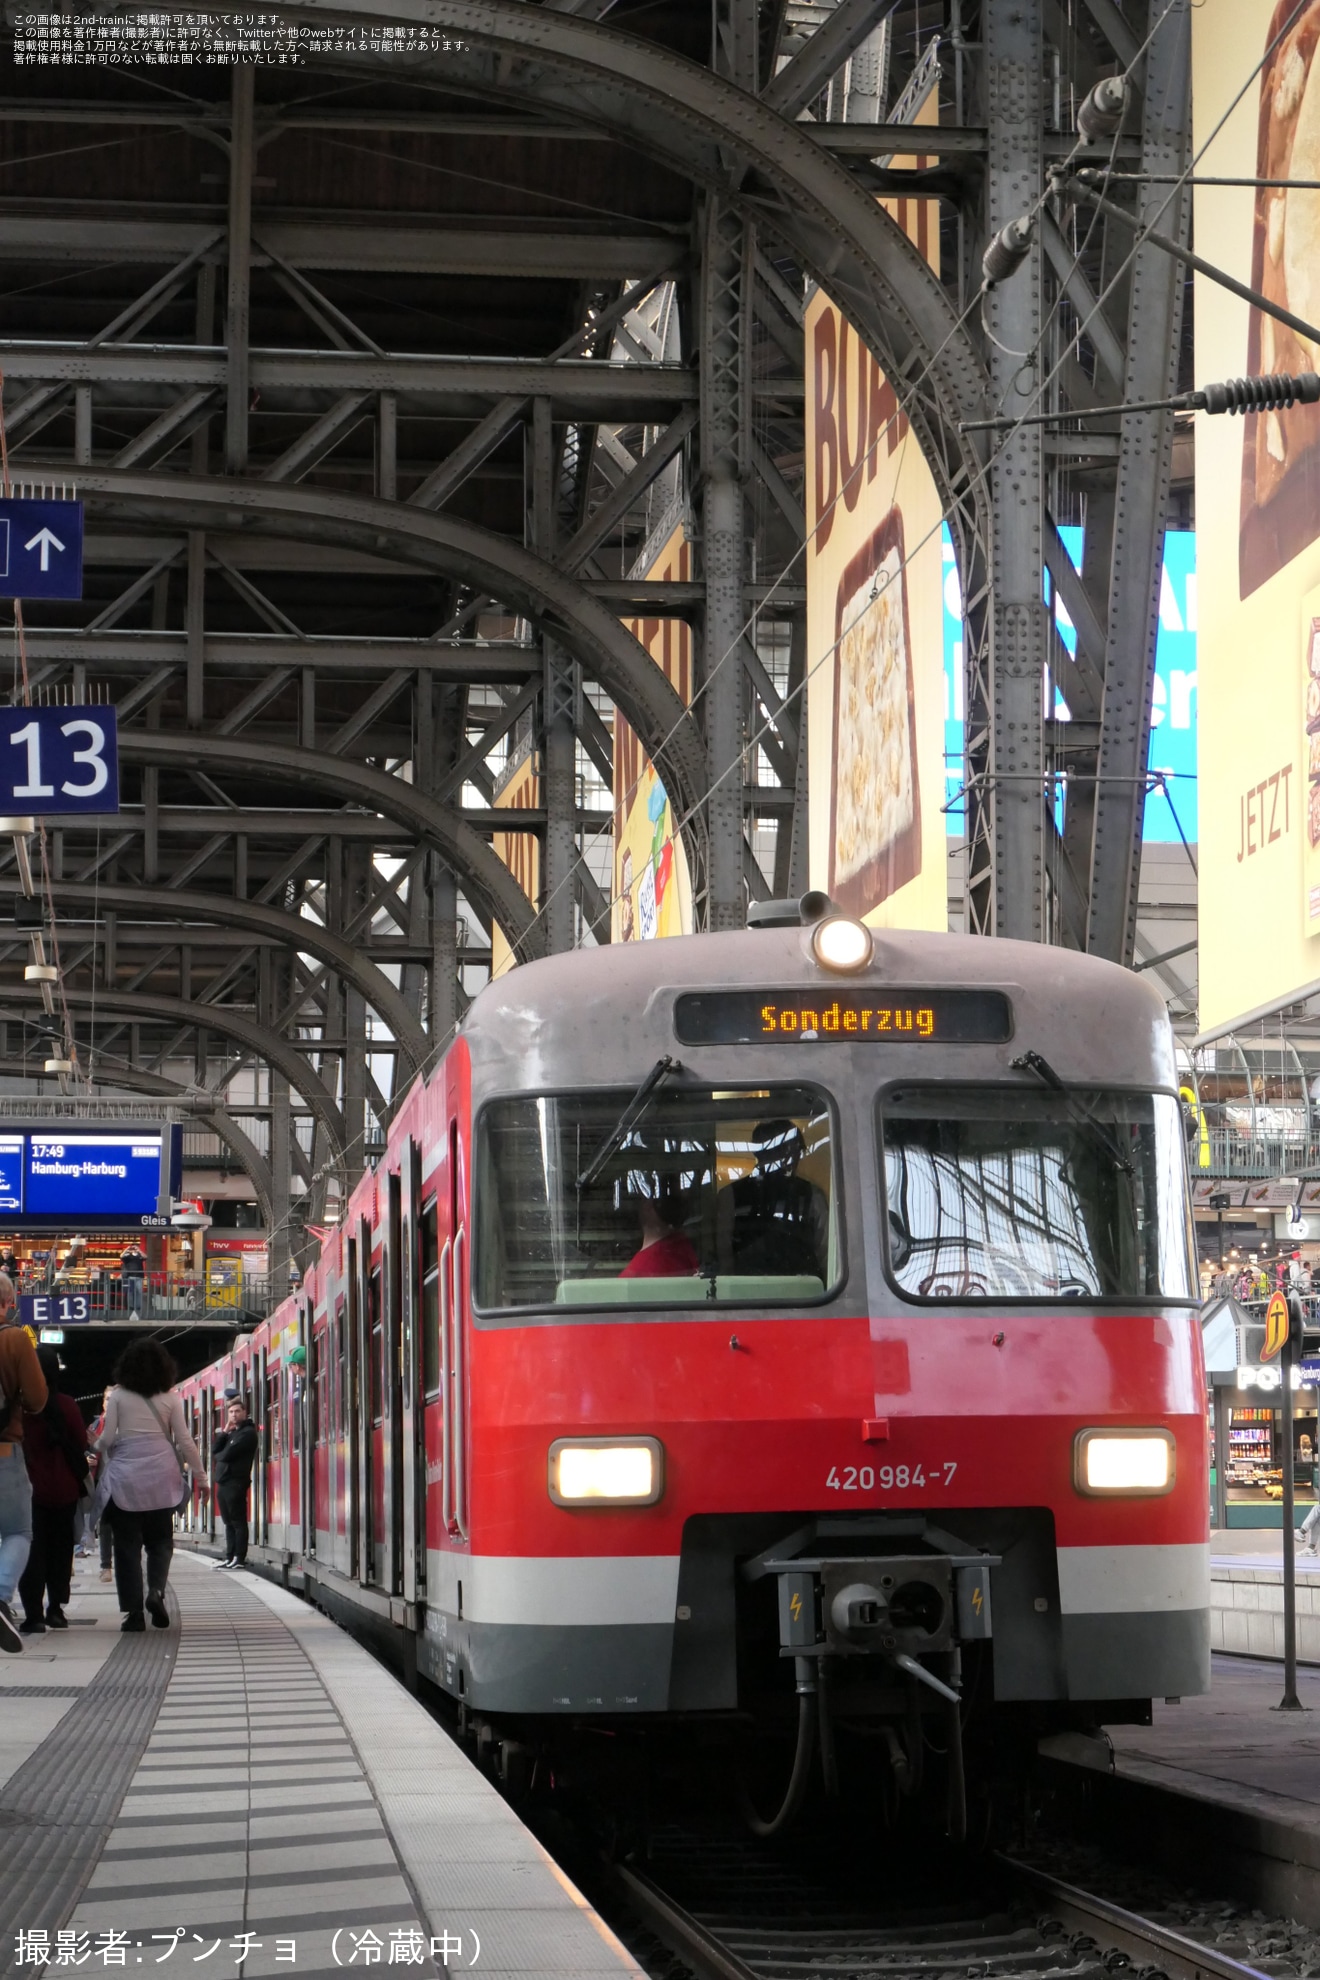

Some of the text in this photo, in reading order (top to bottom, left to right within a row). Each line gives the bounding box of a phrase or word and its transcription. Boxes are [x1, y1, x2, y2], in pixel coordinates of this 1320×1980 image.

[10, 719, 109, 798] 13
[1237, 763, 1293, 864] JETZT
[761, 1003, 934, 1035] Sonderzug
[32, 1145, 64, 1158] 17:49
[32, 1161, 126, 1178] Hamburg-Harburg
[141, 1215, 167, 1226] Gleis
[213, 1241, 230, 1249] hvv
[33, 1296, 87, 1320] E 13
